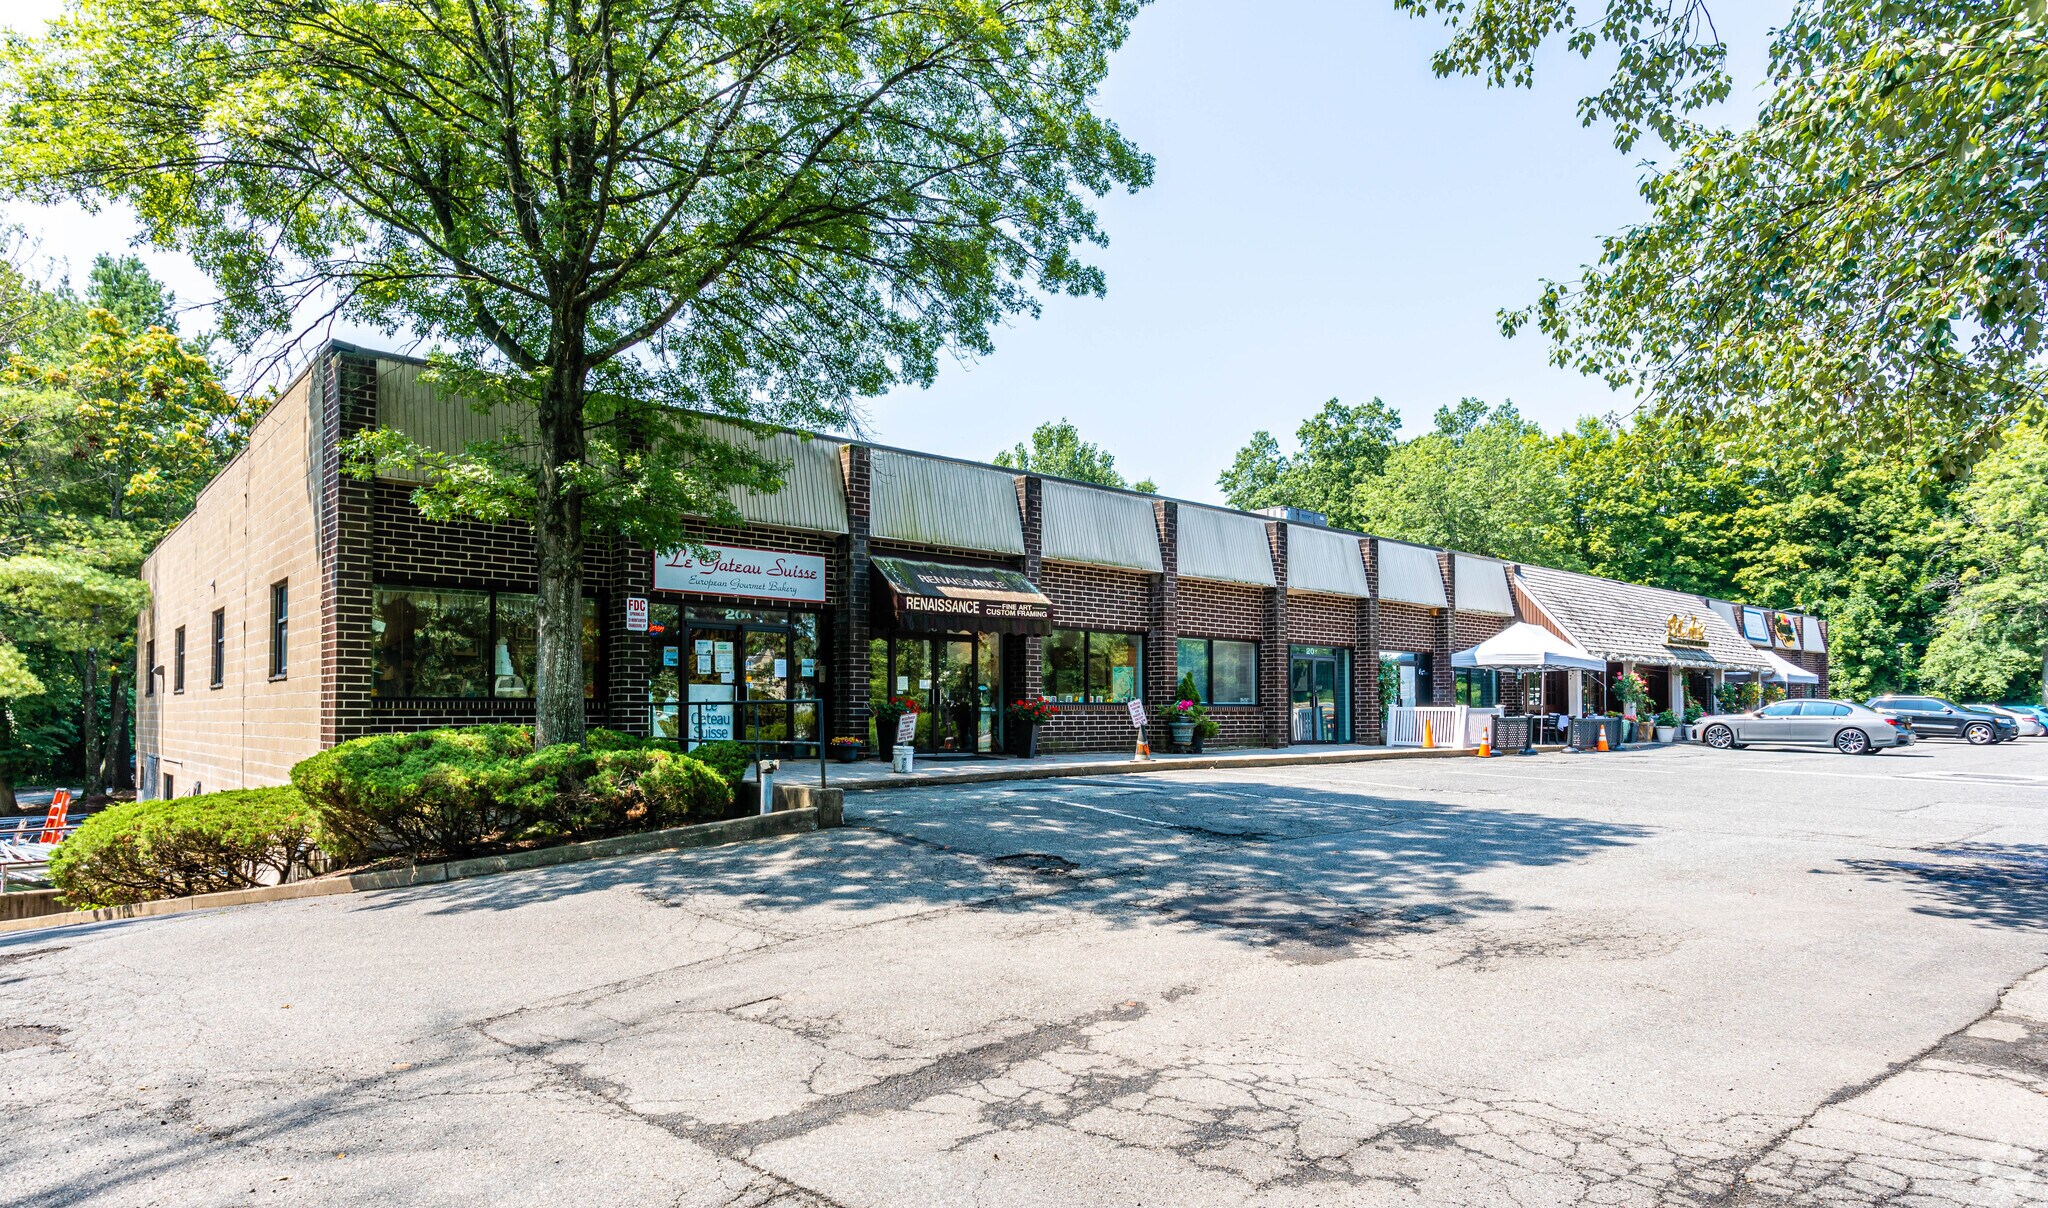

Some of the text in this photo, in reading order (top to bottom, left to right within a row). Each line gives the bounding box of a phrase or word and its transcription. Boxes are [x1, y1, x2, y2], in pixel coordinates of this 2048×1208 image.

[665, 549, 817, 580] Le Gateau Suisse
[688, 575, 797, 596] European Gourmet Bakery
[917, 574, 1008, 589] RENAISSANCE
[628, 599, 646, 611] FDC
[906, 597, 980, 614] RENAISSANCE
[986, 608, 1047, 618] CUSTOM FRAMING
[705, 699, 718, 711] Le
[693, 726, 728, 739] Suisse
